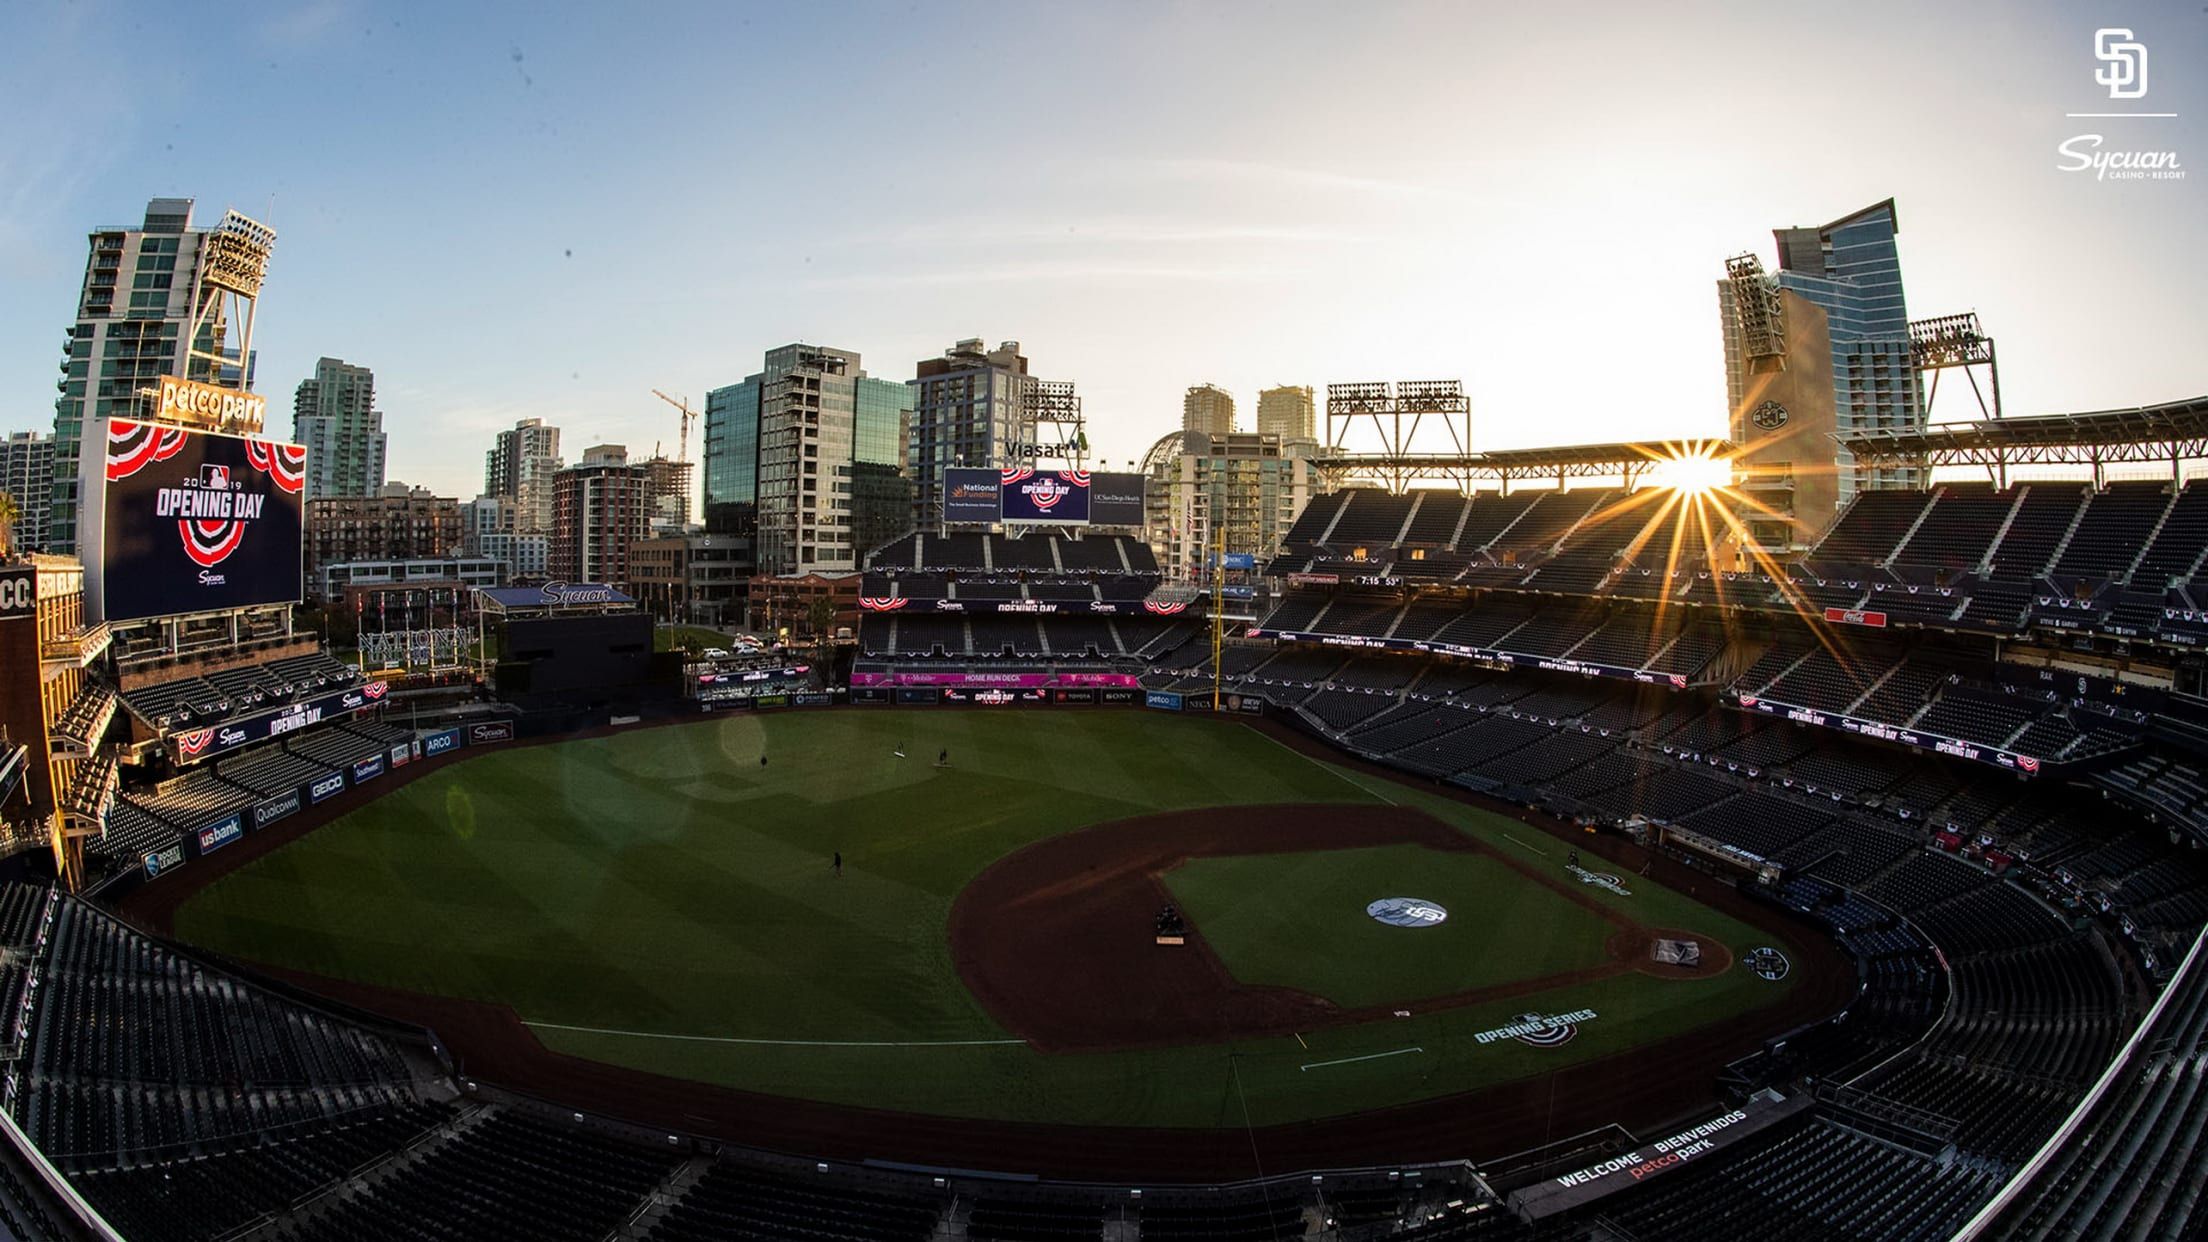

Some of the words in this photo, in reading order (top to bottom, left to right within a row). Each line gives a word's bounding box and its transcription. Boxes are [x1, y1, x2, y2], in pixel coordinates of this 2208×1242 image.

[1005, 441, 1065, 458] Viasat
[963, 483, 998, 491] National
[964, 491, 998, 499] Funding
[1022, 485, 1055, 494] OPENING
[1055, 486, 1070, 495] DAY
[156, 488, 233, 518] OPENING
[234, 492, 265, 519] DAY
[1361, 576, 1380, 585] 7:15
[540, 580, 611, 609] Sycuan
[357, 626, 480, 652] NATIONAL
[965, 674, 985, 682] HOME
[986, 674, 1001, 682] RUN
[1002, 674, 1021, 682] DECK
[1148, 695, 1170, 704] petco
[270, 712, 306, 736] OPENING
[306, 707, 322, 724] DAY
[474, 726, 508, 740] Sycuan
[427, 735, 451, 752] ARCO
[312, 775, 343, 797] GEICO
[256, 797, 298, 823] Qualcomm
[1474, 1021, 1546, 1044] OPENING
[1542, 1008, 1598, 1028] SERIES
[1557, 1152, 1644, 1188] WELCOME
[1653, 1110, 1747, 1153] BIENVENIDOS
